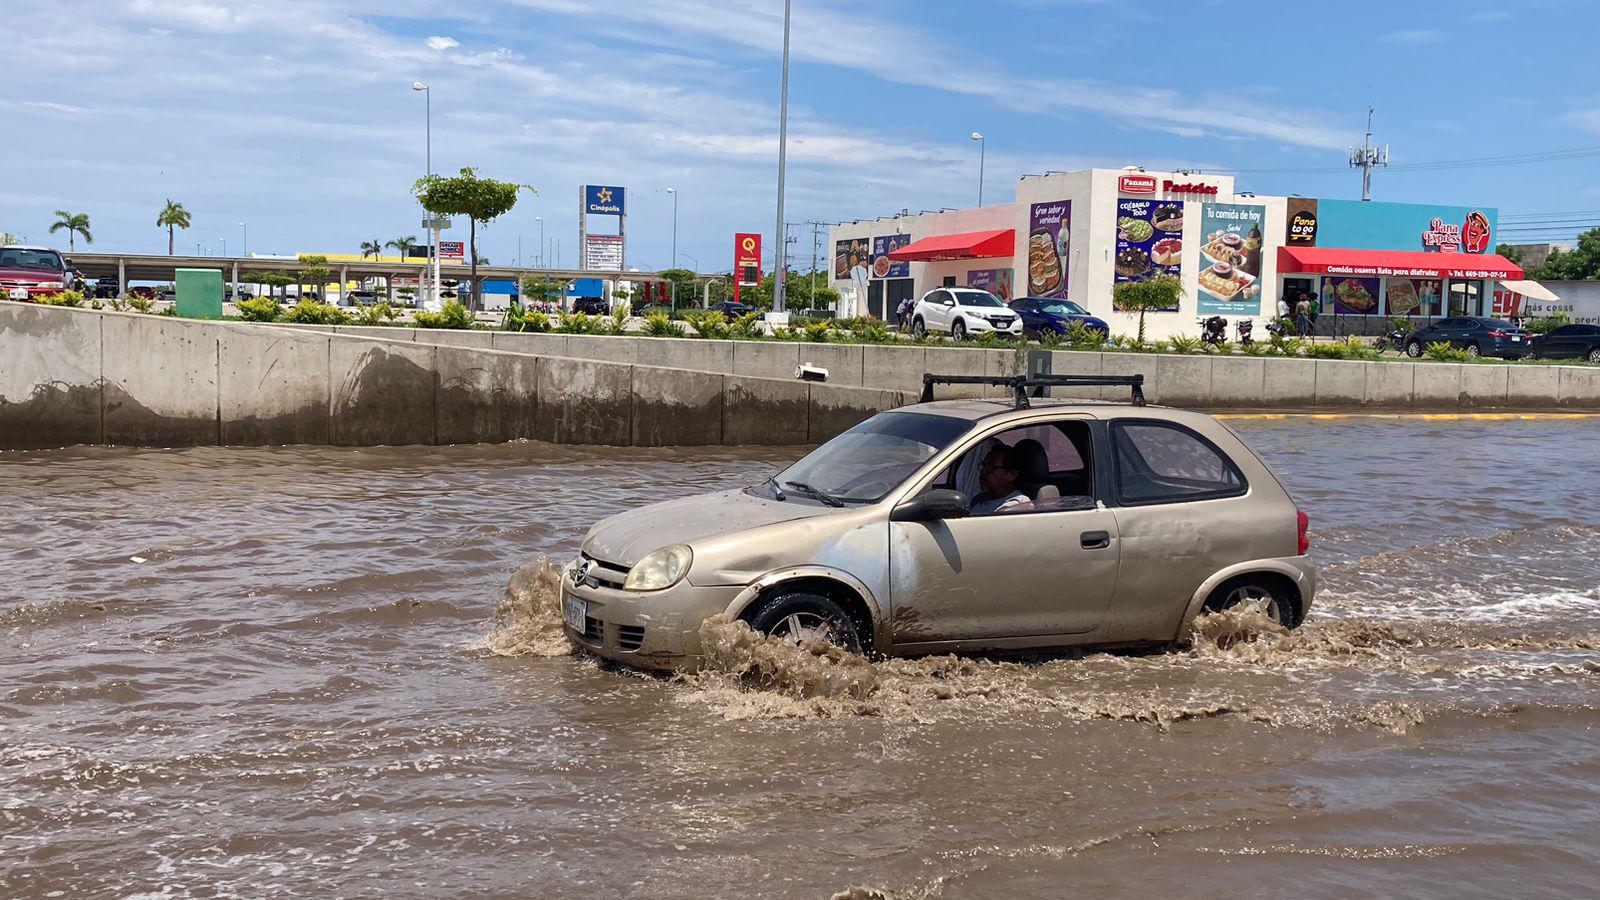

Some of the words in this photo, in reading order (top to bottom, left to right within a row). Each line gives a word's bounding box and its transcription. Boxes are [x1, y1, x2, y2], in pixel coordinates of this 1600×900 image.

[1123, 178, 1154, 187] Panamá
[1162, 180, 1218, 194] Pasteles
[590, 204, 620, 212] Cinópolis
[1035, 205, 1047, 218] Gran
[1048, 204, 1062, 214] sabor
[1039, 215, 1061, 225] variedad
[1206, 207, 1214, 218] Tu
[1215, 208, 1239, 219] comida
[1240, 210, 1248, 220] de
[1249, 210, 1261, 223] hoy
[1293, 216, 1315, 226] Pana
[1431, 217, 1459, 233] Pana
[1292, 224, 1302, 232] to
[1302, 226, 1314, 235] go
[1422, 231, 1461, 245] Express
[1327, 265, 1353, 273] Comida
[1377, 267, 1393, 275] lista
[1393, 268, 1409, 276] para
[1410, 268, 1439, 276] disfrutar
[1453, 269, 1465, 277] Tel.
